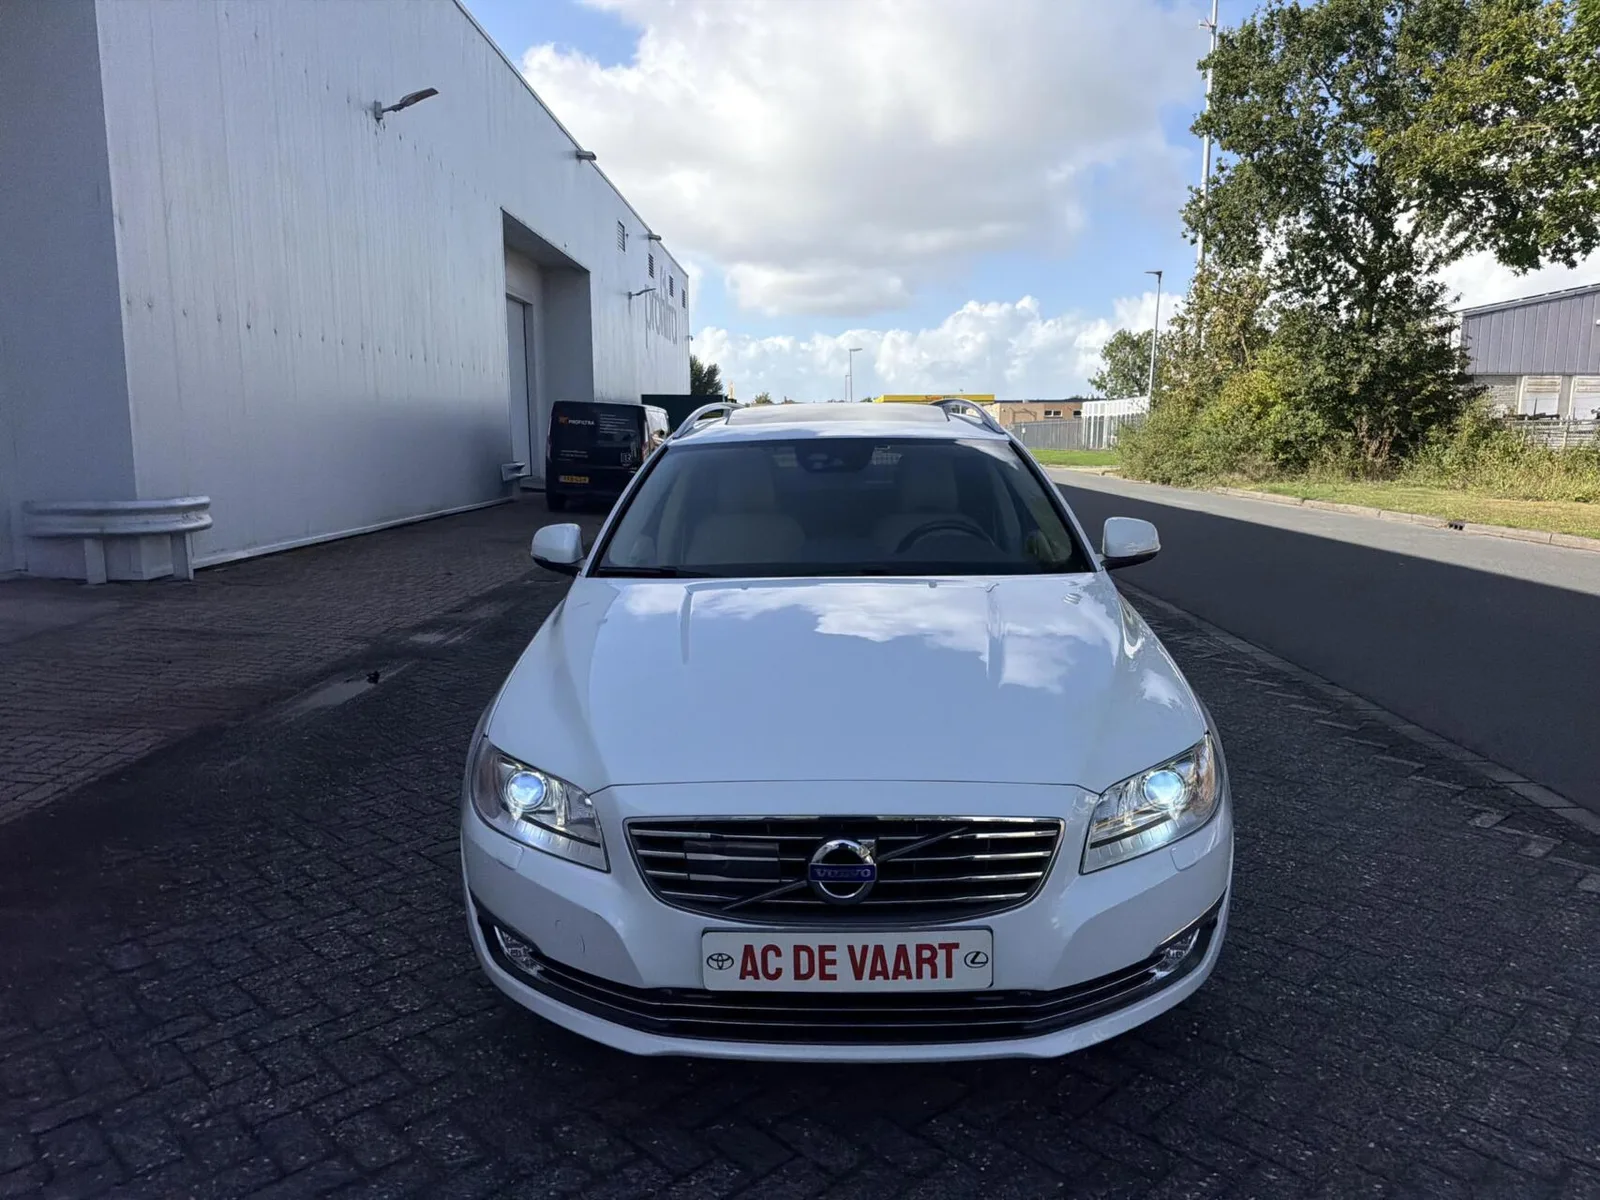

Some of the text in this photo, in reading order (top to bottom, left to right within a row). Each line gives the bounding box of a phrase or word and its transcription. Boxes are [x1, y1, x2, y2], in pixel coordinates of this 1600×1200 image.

[815, 868, 872, 878] VOLVO
[739, 942, 960, 981] AC DE VAART
